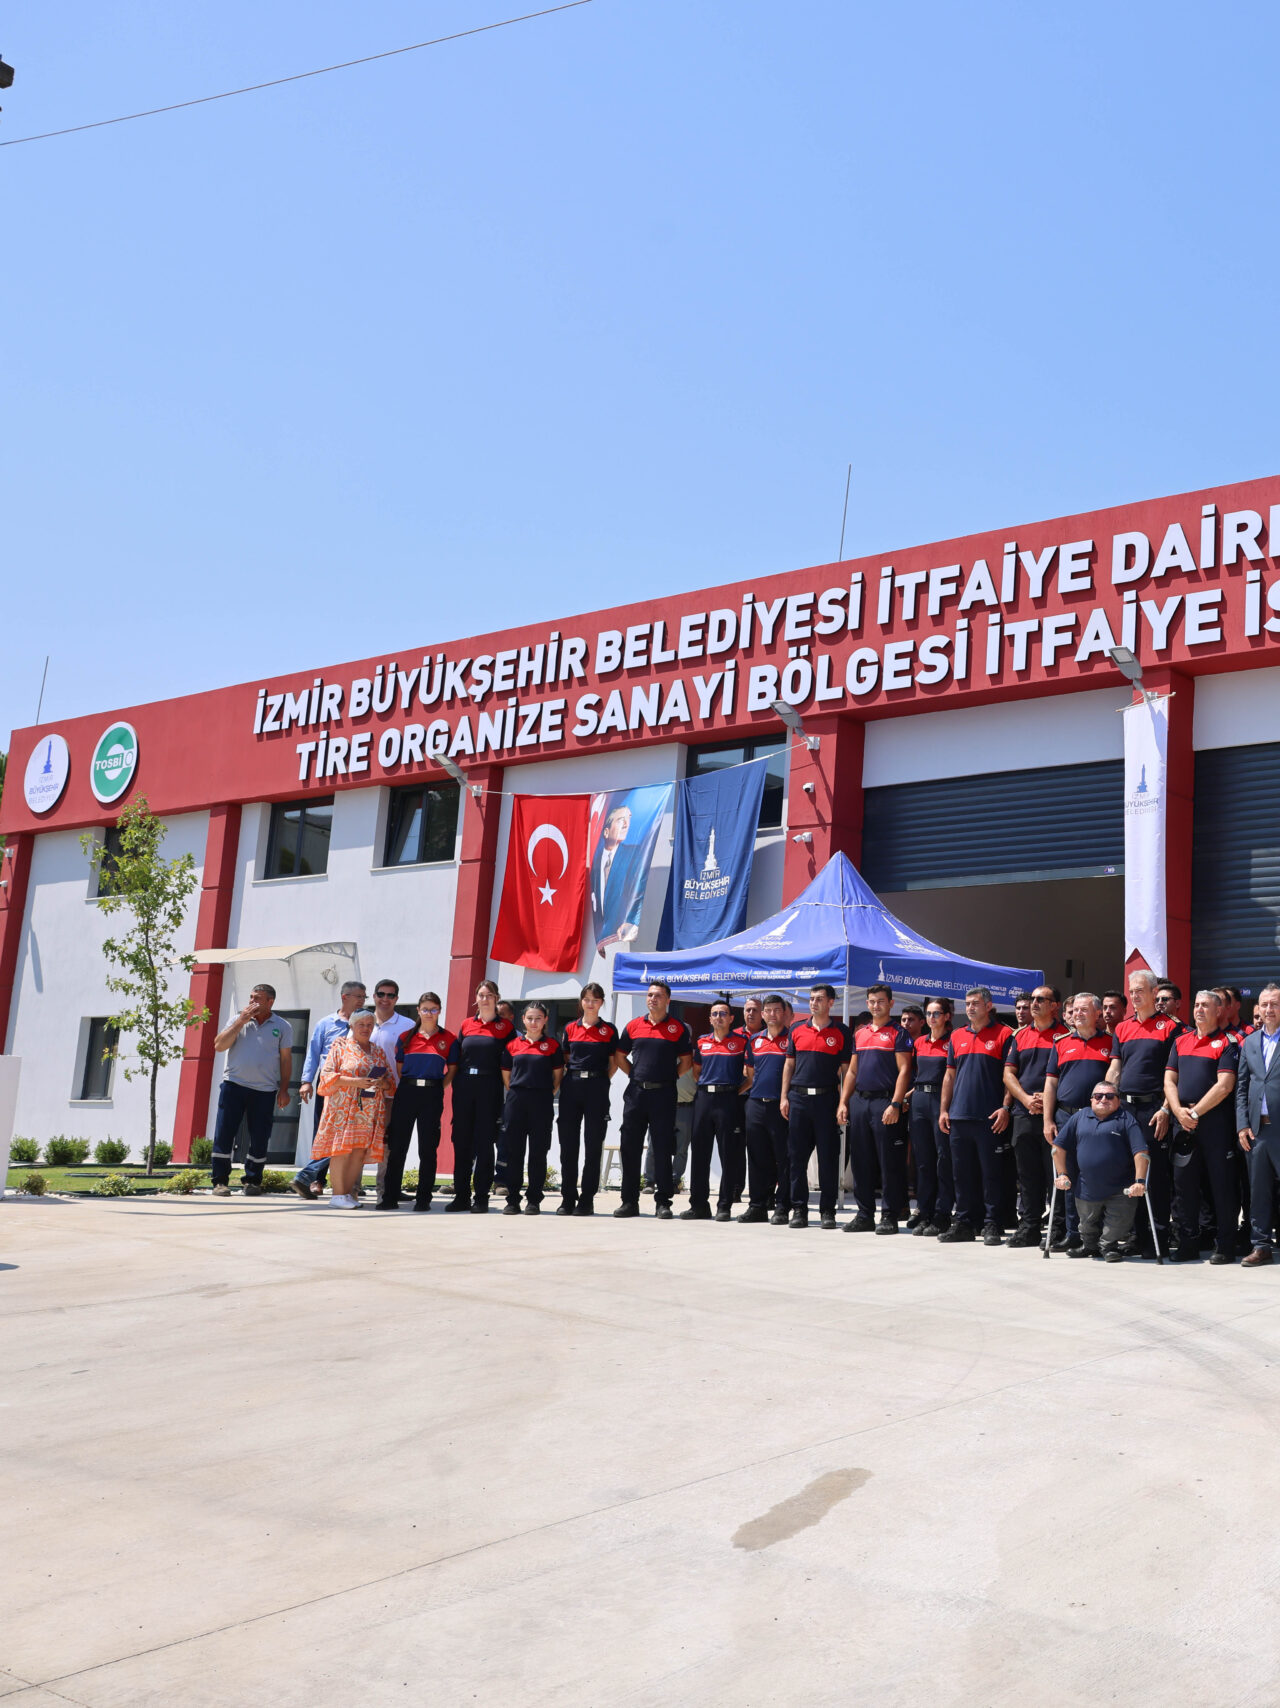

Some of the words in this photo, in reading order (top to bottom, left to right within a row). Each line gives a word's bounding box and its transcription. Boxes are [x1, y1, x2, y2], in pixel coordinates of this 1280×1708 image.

[253, 678, 343, 734] İZMİR
[348, 631, 588, 718] BÜYÜKŞEHİR
[594, 571, 863, 674] BELEDİYESİ
[877, 541, 1093, 625] İTFAİYE
[296, 730, 371, 780] TİRE
[377, 698, 566, 768] ORGANİZE
[571, 659, 737, 738] SANAYİ
[747, 618, 970, 712] BÖLGESİ
[985, 589, 1223, 676] İTFAİYE
[95, 754, 123, 770] TOSBİ
